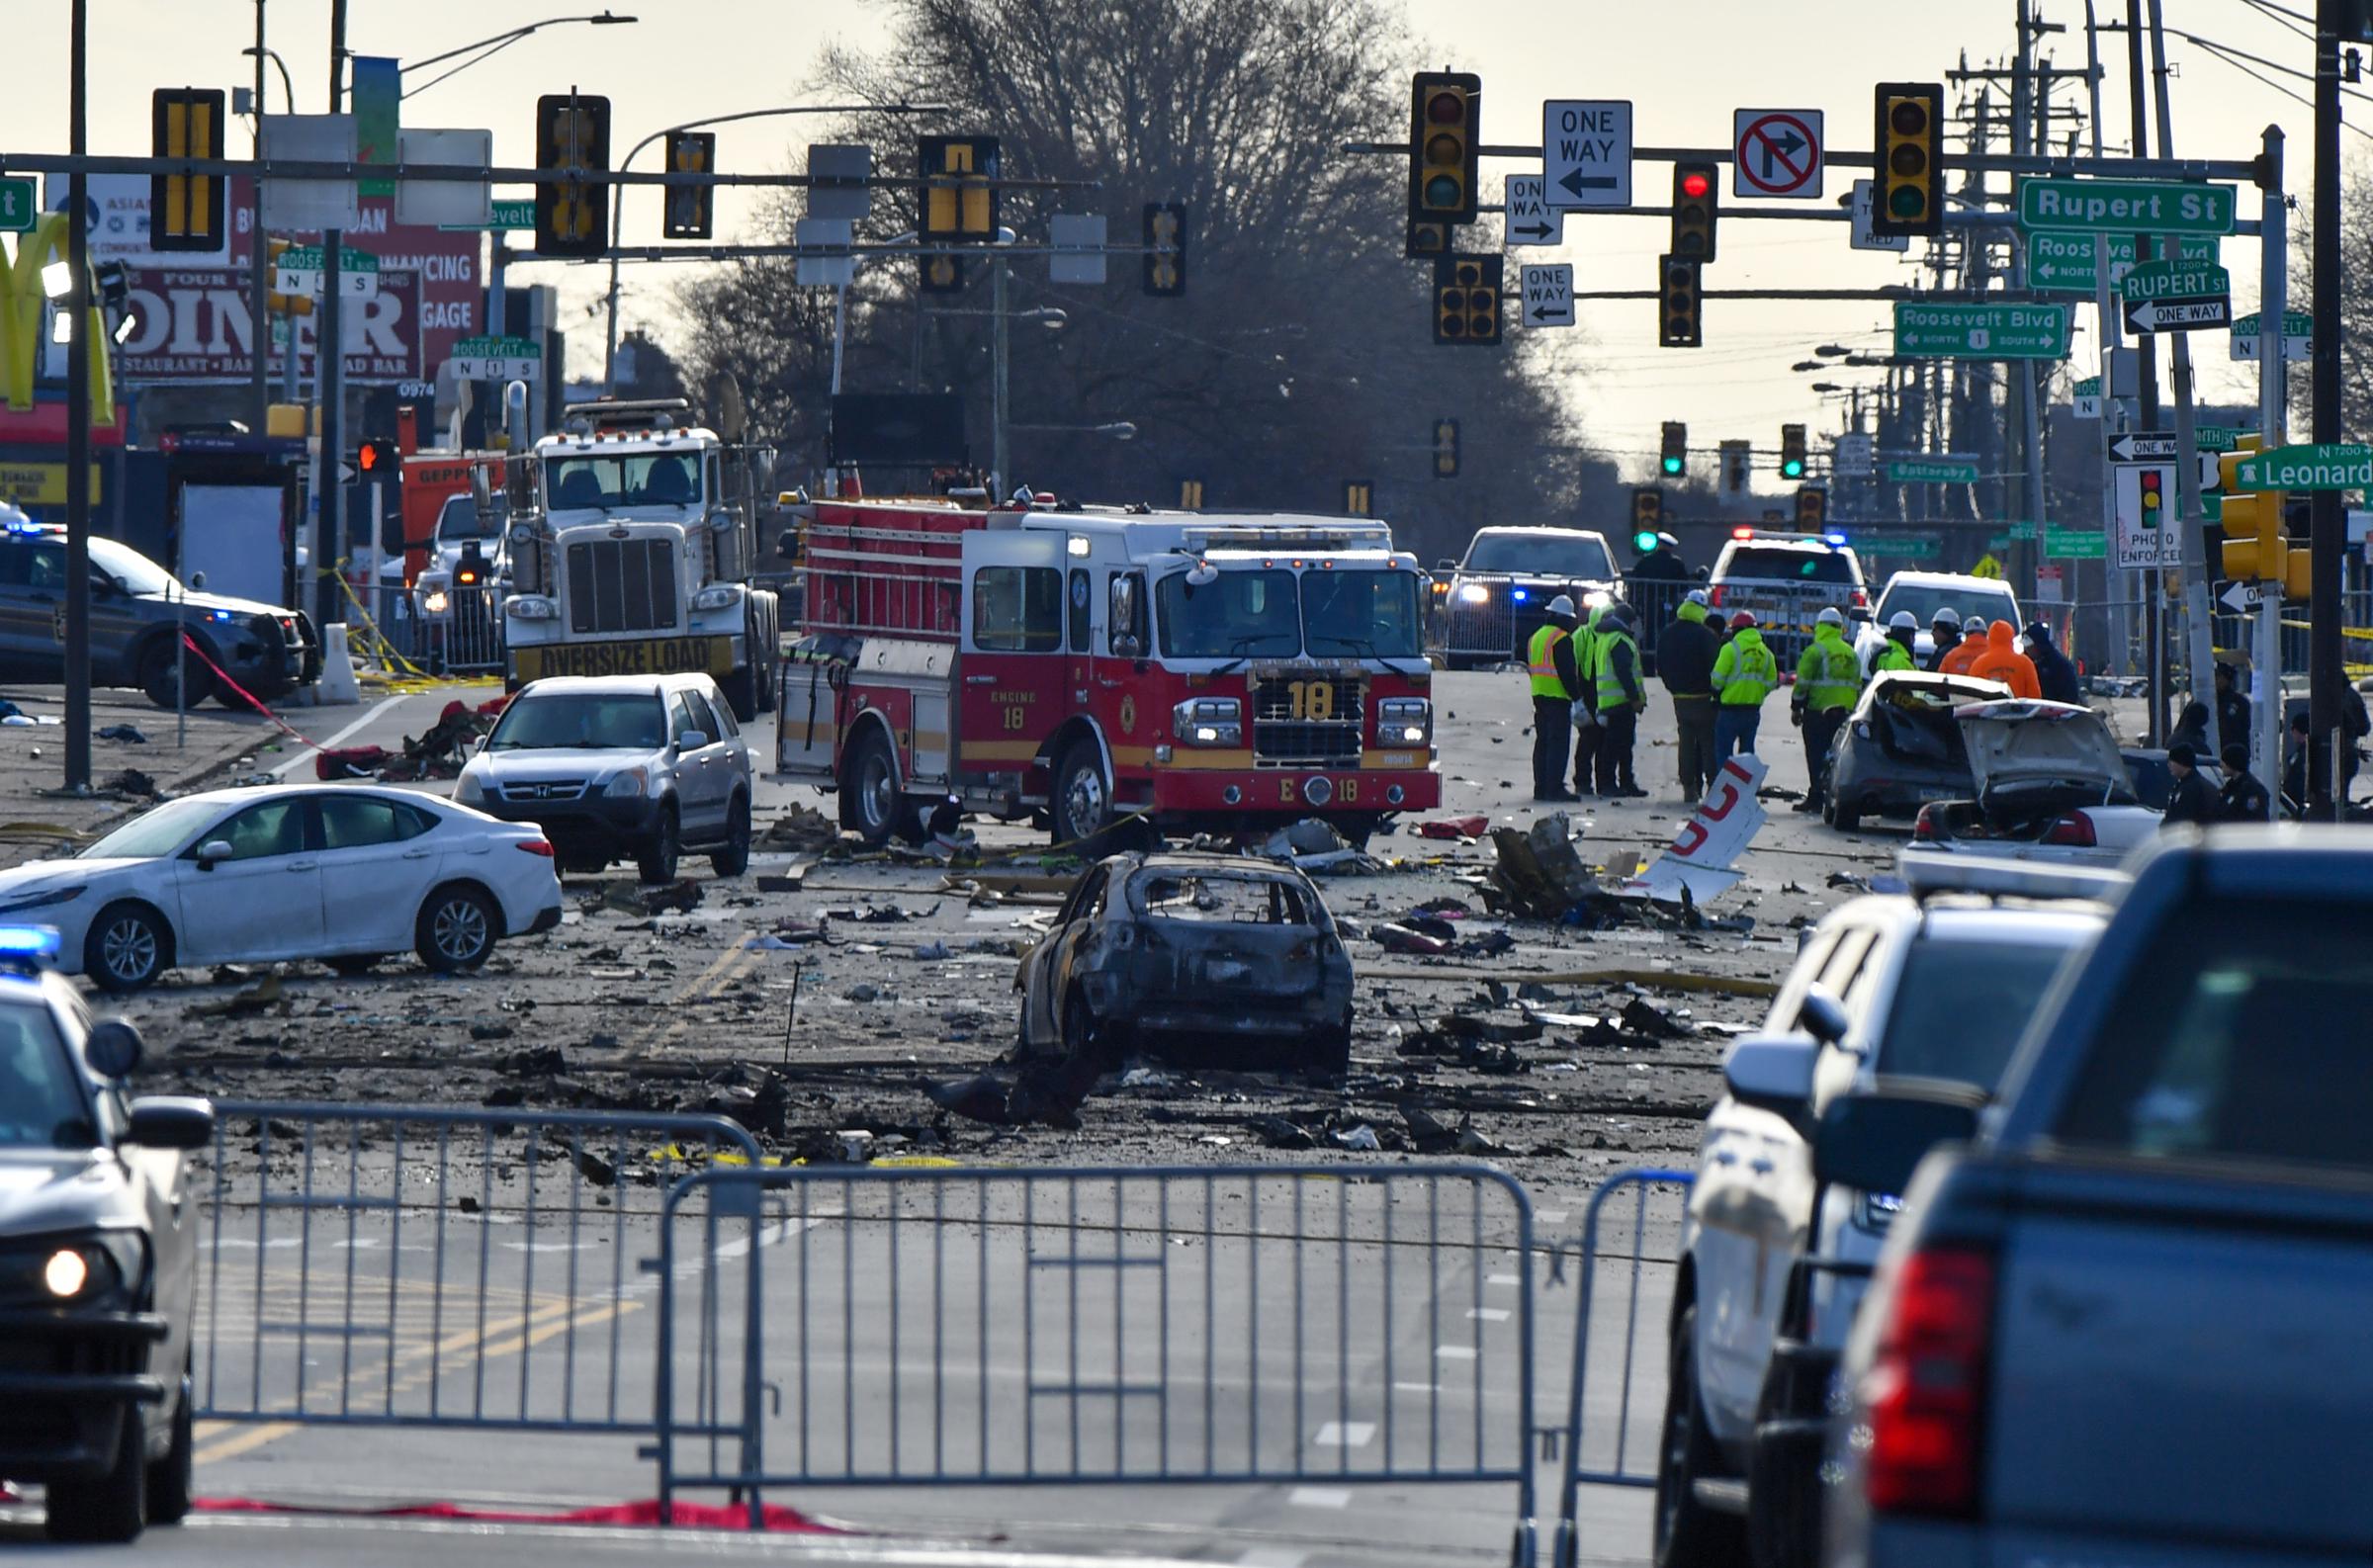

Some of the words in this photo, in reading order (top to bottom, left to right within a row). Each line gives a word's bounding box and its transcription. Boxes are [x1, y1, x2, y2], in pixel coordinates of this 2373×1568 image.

[1561, 110, 1614, 132] ONE
[1560, 139, 1615, 162] WAY
[1514, 182, 1541, 197] ON
[2038, 189, 2161, 221] Rupert
[2180, 194, 2218, 221] St
[491, 205, 535, 224] evelt
[1865, 232, 1894, 245] RED
[279, 252, 354, 268] ROOSELT
[288, 275, 300, 288] N
[356, 278, 366, 290] S
[1529, 270, 1564, 285] ONE
[2127, 272, 2208, 297] RUPERT
[2213, 278, 2227, 291] ST
[1529, 288, 1565, 302] WAY
[1902, 309, 2002, 327] Roosevelt
[2011, 311, 2056, 327] Blvd
[2156, 306, 2185, 322] ONE
[2190, 305, 2219, 318] WAY
[1922, 335, 1960, 344] NORTH
[1999, 336, 2036, 345] SOUTH
[2240, 341, 2251, 354] N
[452, 342, 518, 356] ROOSEVELT
[460, 361, 472, 375] N
[521, 363, 531, 376] S
[2135, 441, 2158, 453] ONE
[2319, 446, 2330, 459] N
[2334, 447, 2361, 456] 7200
[2265, 459, 2373, 485] Leonard
[2132, 533, 2174, 545] PHOO
[540, 642, 647, 677] OVERSIZE
[651, 639, 710, 670] LOAD
[991, 691, 1036, 703] ENGINE
[1287, 680, 1333, 722] 18
[1004, 707, 1024, 730] 18
[1280, 779, 1294, 802] E
[1338, 779, 1359, 802] 18
